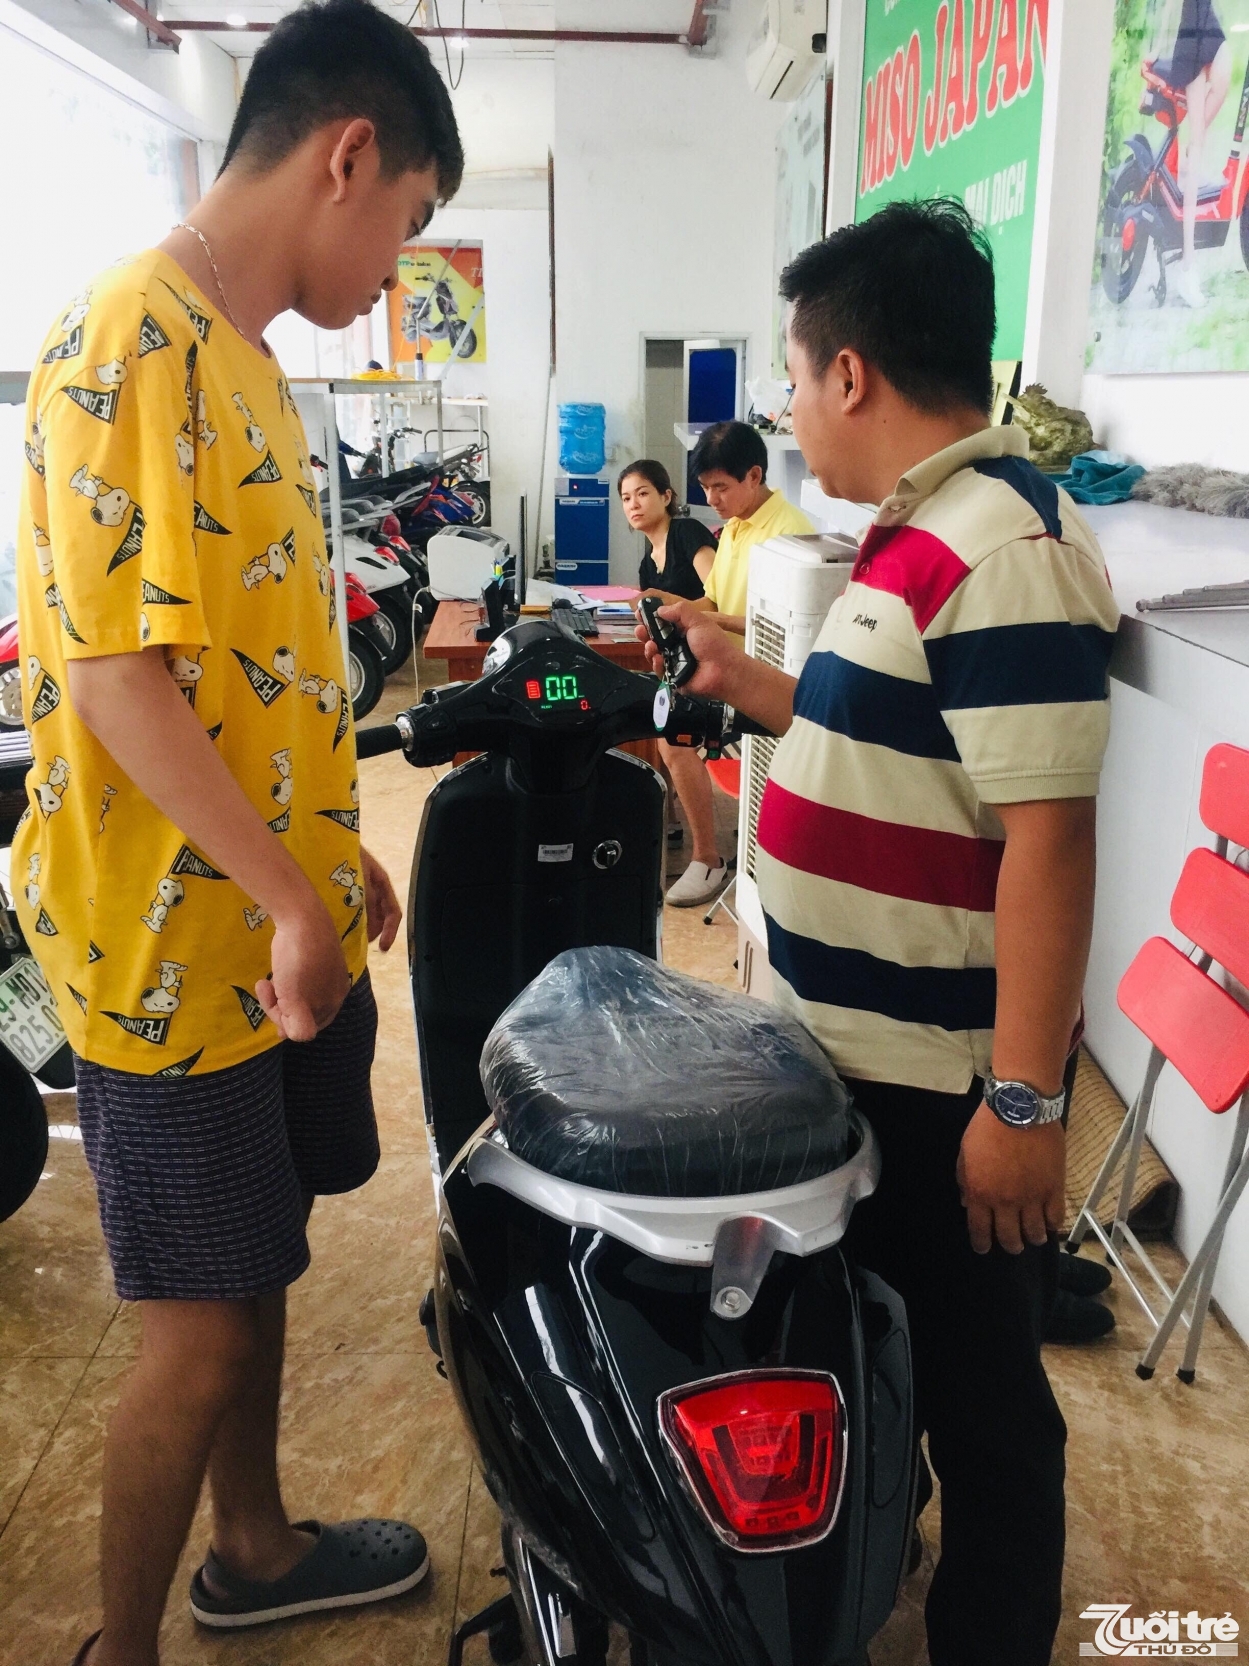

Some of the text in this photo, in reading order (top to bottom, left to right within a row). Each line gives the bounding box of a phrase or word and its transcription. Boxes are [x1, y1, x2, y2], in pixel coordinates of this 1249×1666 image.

[860, 0, 1050, 198] MISO JAPAN
[990, 160, 1027, 235] DỊCH
[68, 386, 114, 420] PEANUTS
[242, 658, 282, 703] PEANUTS
[9, 998, 65, 1063] 825.0
[117, 1014, 165, 1042] PEANUTS
